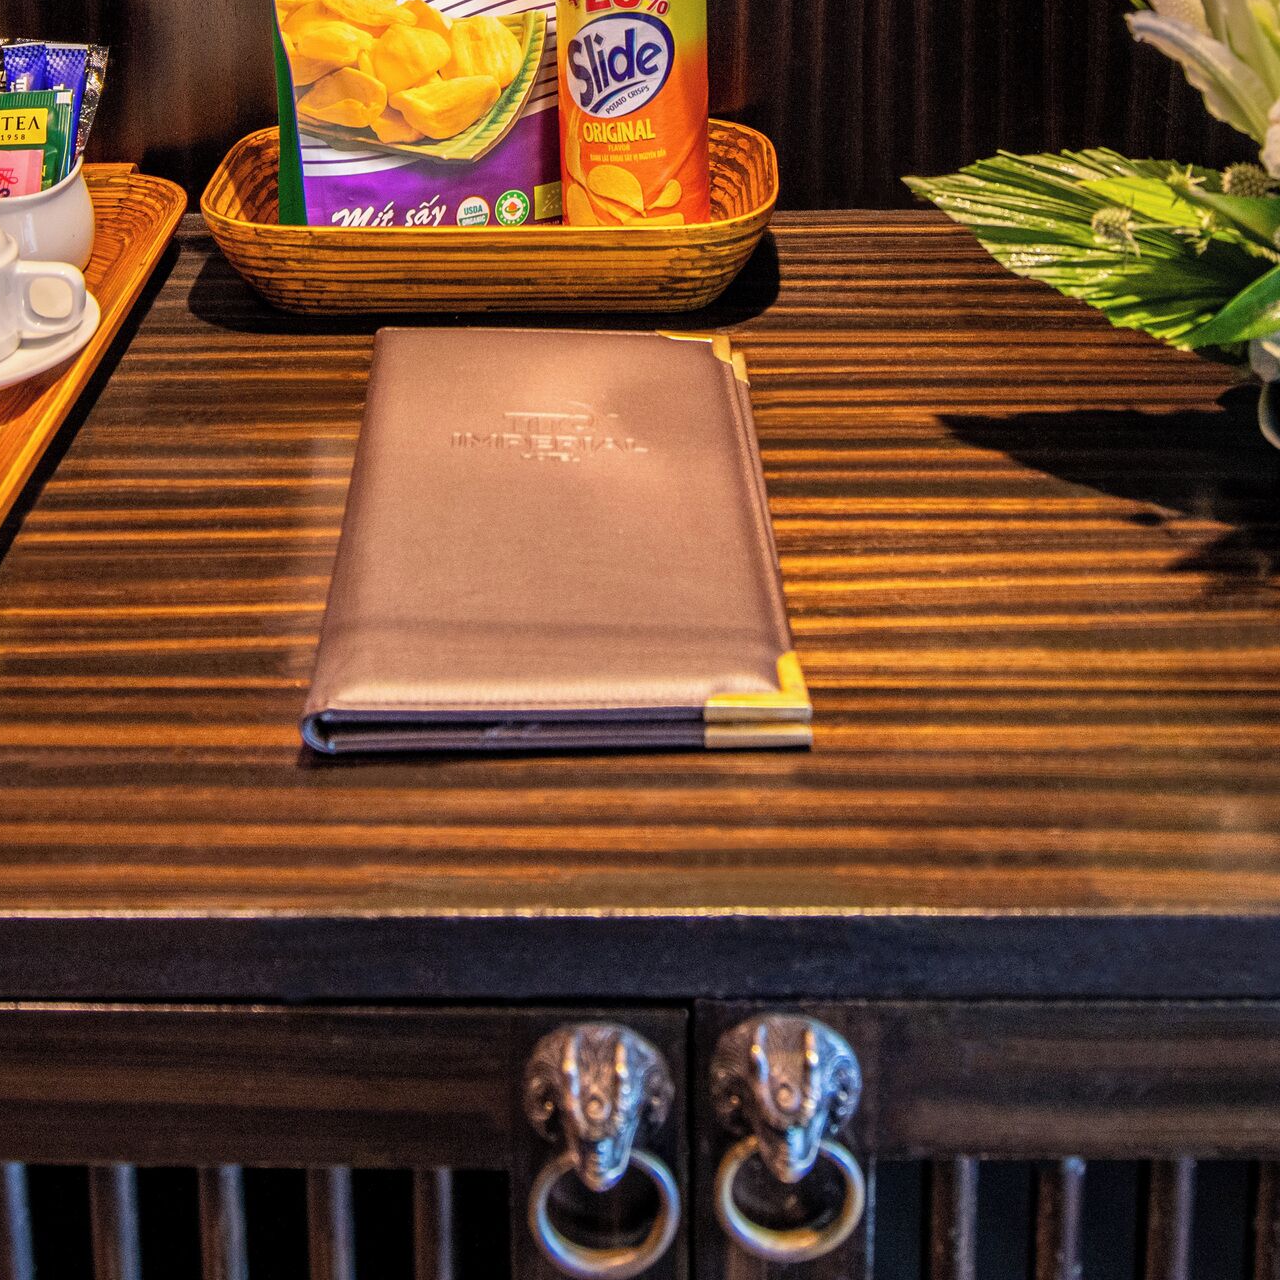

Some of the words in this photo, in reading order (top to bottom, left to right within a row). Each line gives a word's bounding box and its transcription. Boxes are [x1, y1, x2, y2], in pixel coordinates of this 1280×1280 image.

[568, 28, 663, 108] Slide
[605, 97, 627, 115] POTATO
[627, 85, 650, 99] CRISPS
[0, 133, 26, 141] 1958
[583, 118, 656, 143] ORIGINAL
[405, 195, 447, 227] sấy
[464, 205, 483, 216] USDA
[451, 432, 649, 453] IMPERIAL
